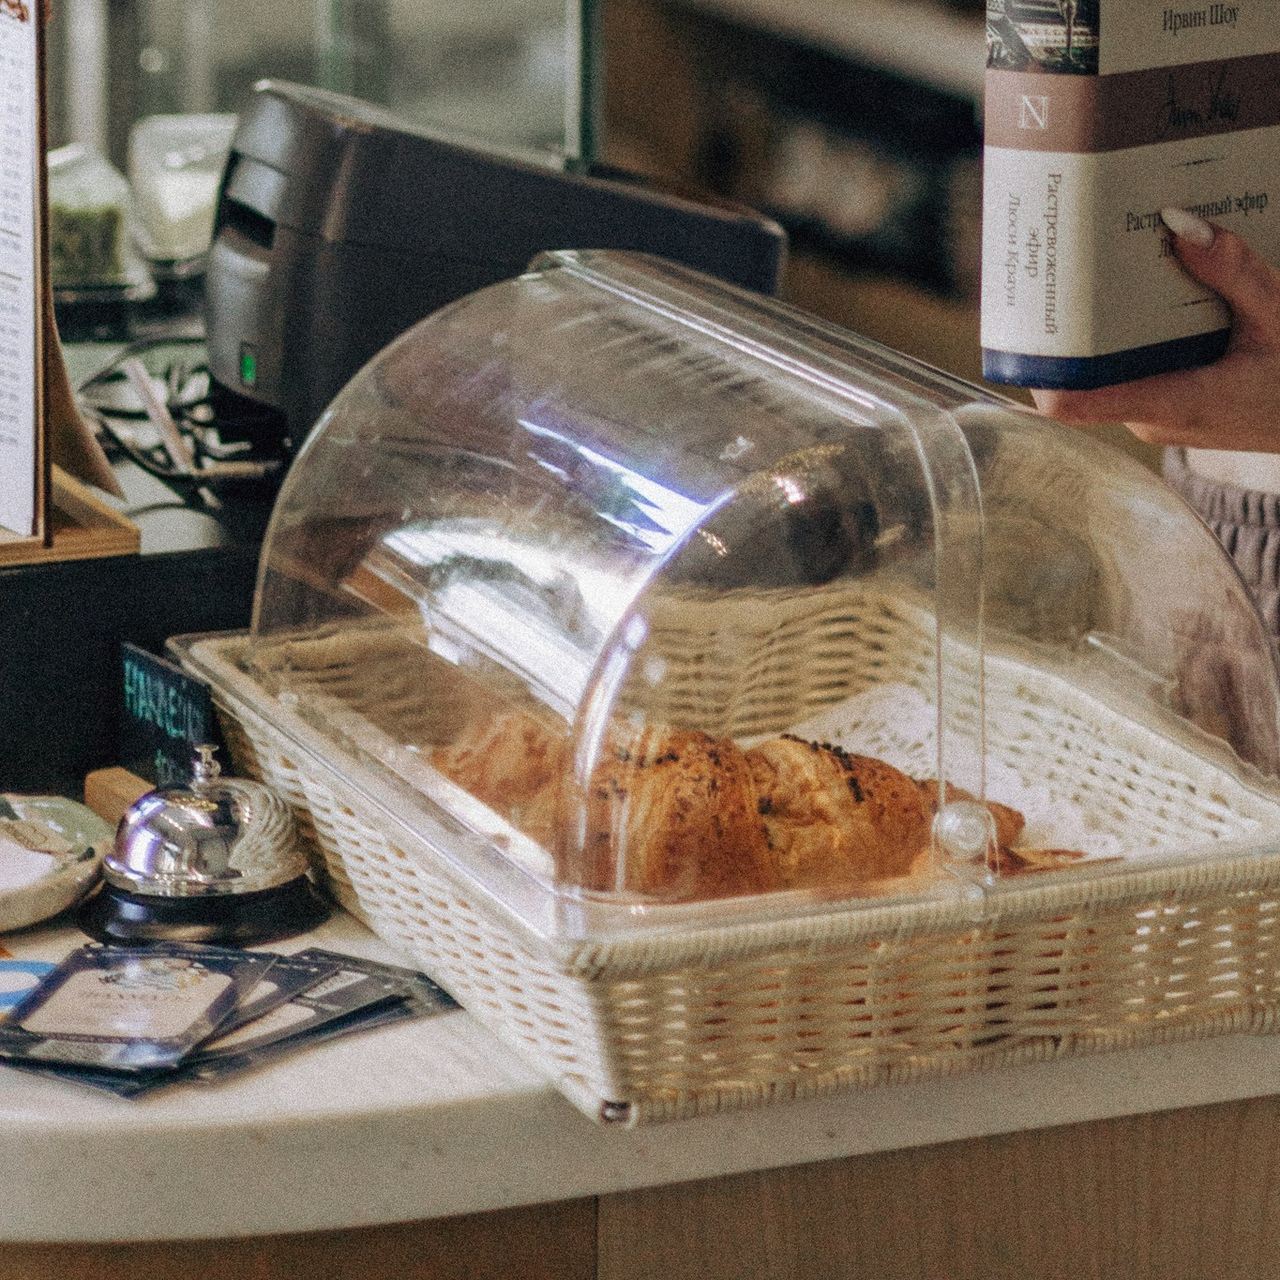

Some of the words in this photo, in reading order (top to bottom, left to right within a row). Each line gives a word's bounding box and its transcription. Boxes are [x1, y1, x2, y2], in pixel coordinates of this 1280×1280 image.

[1162, 9, 1207, 37] Ирвин
[1209, 3, 1240, 29] Шоу
[1017, 94, 1048, 130] N
[1007, 191, 1021, 245] Люси
[1233, 190, 1269, 216] эфир
[1003, 250, 1019, 306] Краун
[1024, 226, 1043, 278] эфир
[1043, 172, 1062, 334] Растревоженный
